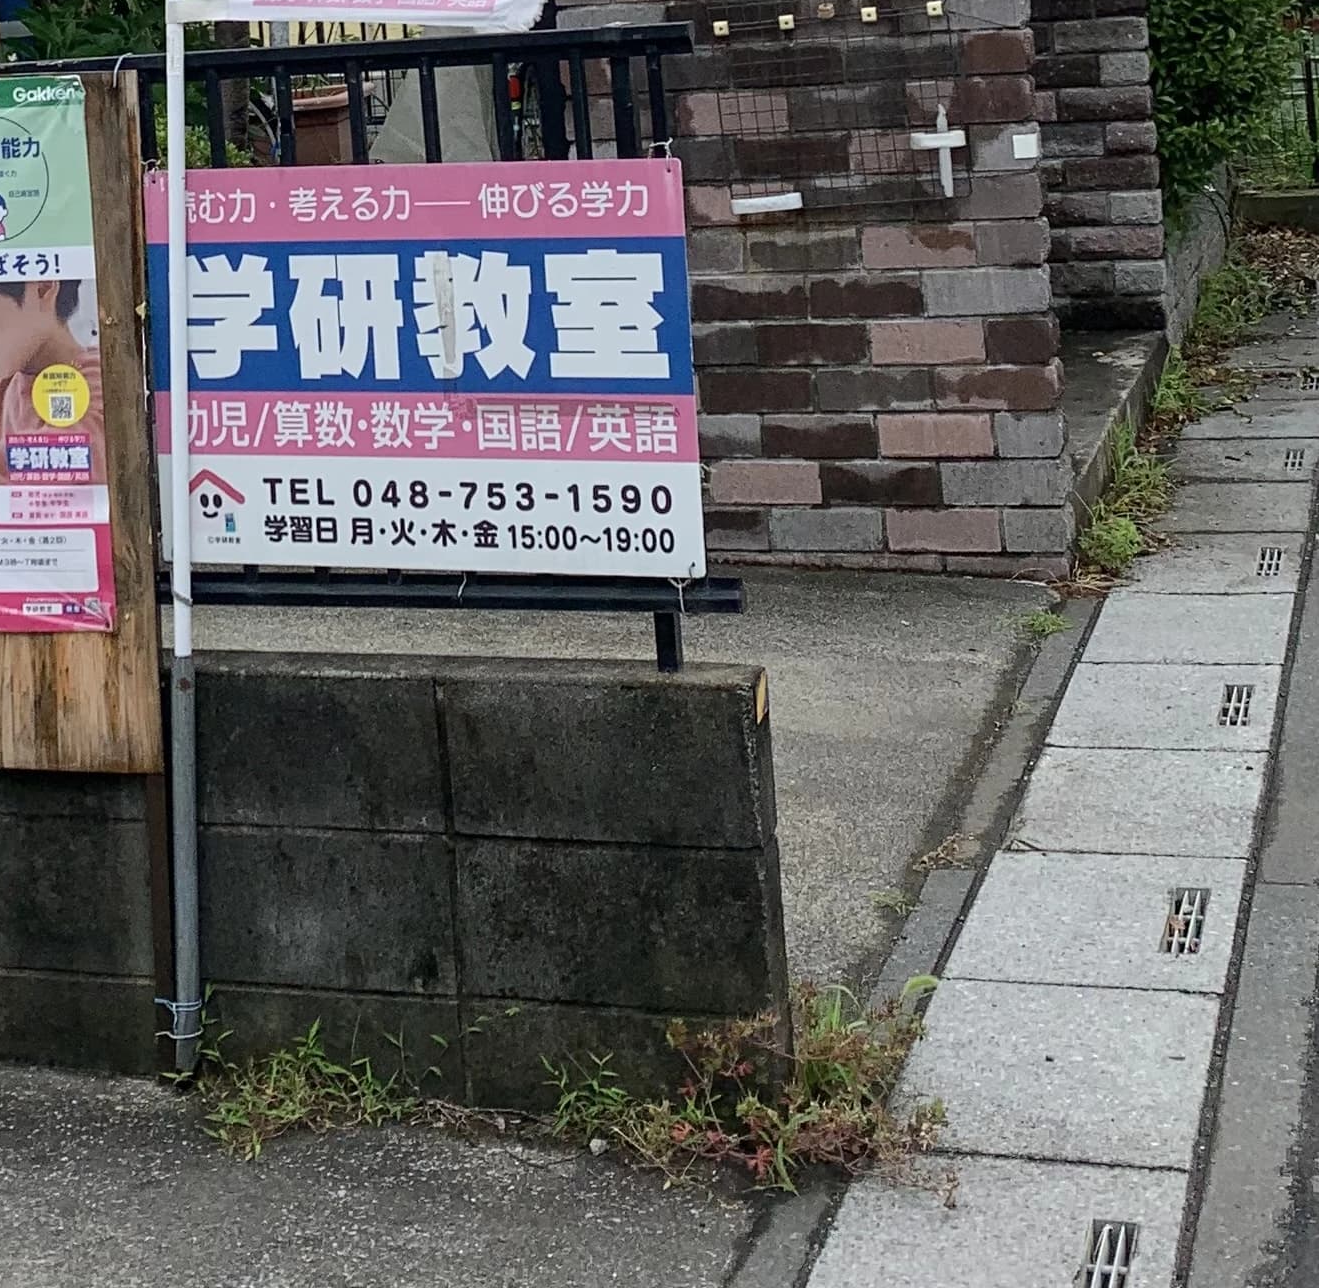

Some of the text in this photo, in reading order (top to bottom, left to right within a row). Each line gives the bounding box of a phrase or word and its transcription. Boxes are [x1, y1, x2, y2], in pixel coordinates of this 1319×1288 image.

[13, 86, 76, 102] Gakken
[168, 249, 671, 380] 学研教室
[9, 446, 89, 469] 学研教室
[263, 477, 673, 513] TEL 048-753-1590
[264, 515, 339, 544] 学習日
